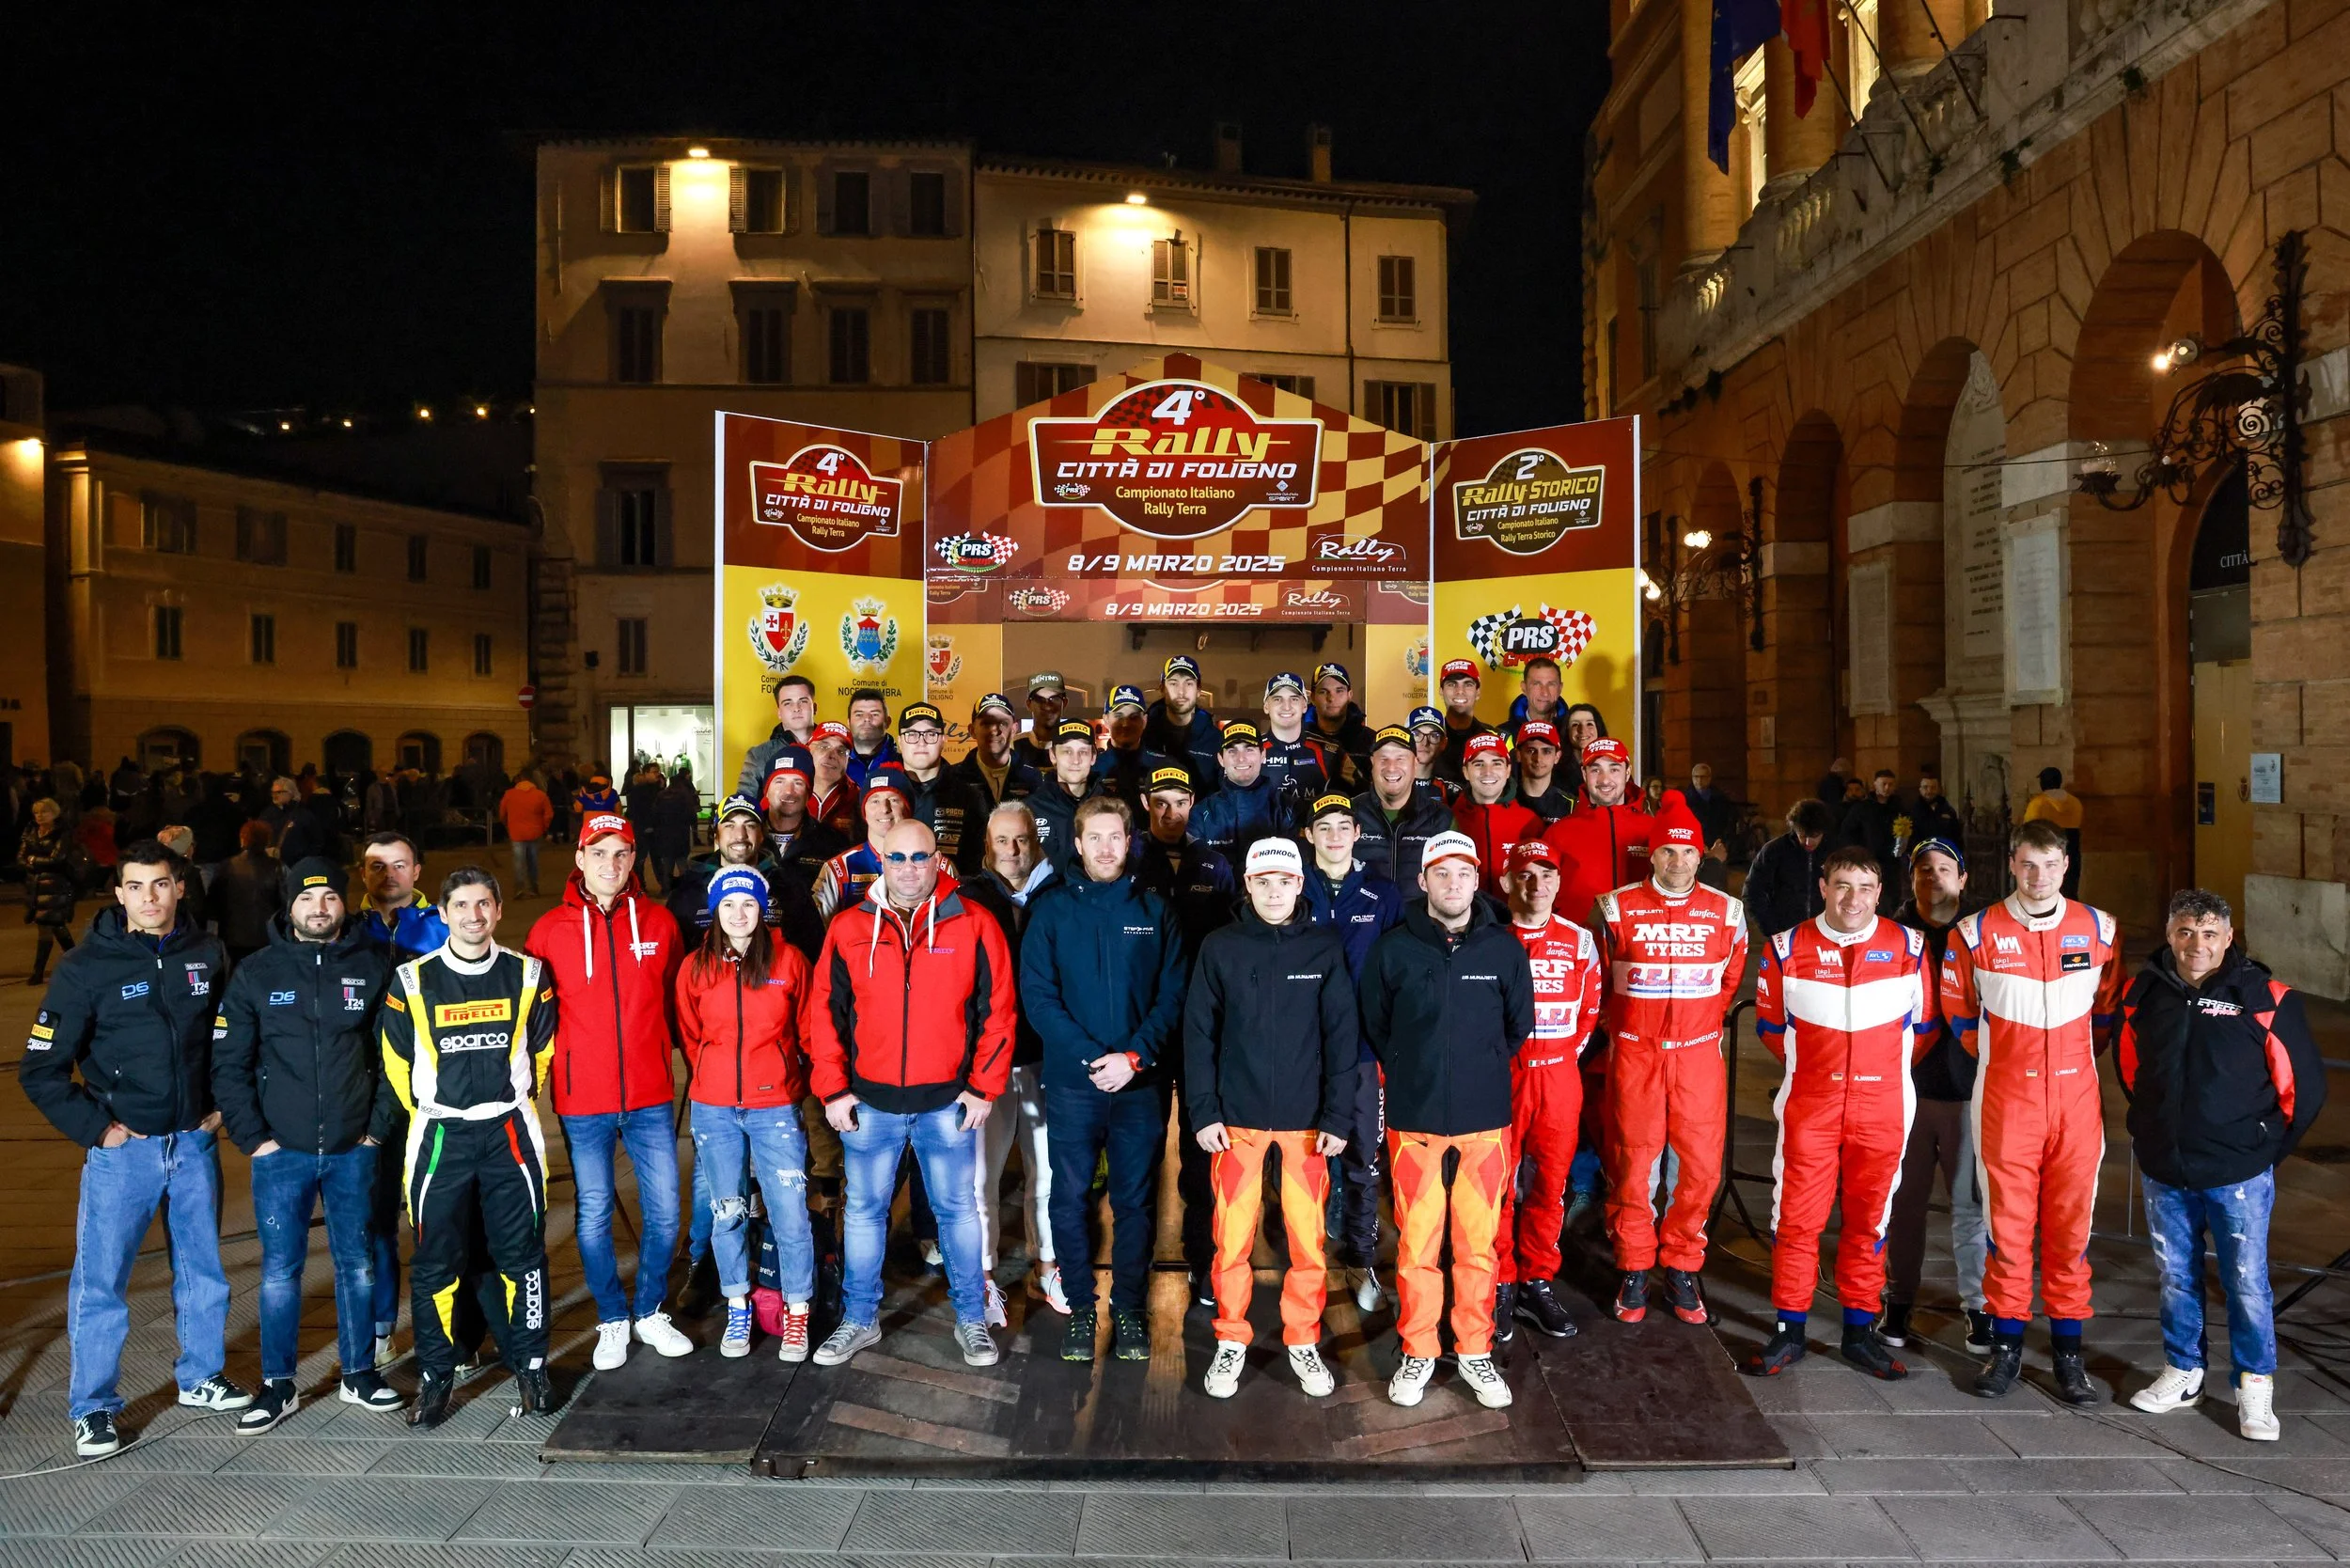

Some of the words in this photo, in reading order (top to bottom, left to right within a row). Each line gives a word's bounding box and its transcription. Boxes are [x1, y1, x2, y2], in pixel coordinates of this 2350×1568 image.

[1152, 390, 1206, 425] 4°
[1089, 427, 1291, 463] Rally
[817, 452, 845, 477] 4°
[1057, 458, 1140, 478] CITTÀ
[1146, 463, 1175, 478] DI
[1181, 463, 1297, 478] FOLIGNO
[1515, 454, 1544, 479] 2°
[784, 473, 887, 505] Rally
[1116, 486, 1188, 501] Campionato
[1190, 486, 1235, 499] Italiano
[1462, 483, 1527, 506] Rally
[1529, 476, 1598, 499] STORICO
[765, 494, 810, 509] CITTÀ
[814, 499, 828, 510] DI
[832, 501, 890, 517] FOLIGNO
[1144, 502, 1174, 517] Rally
[1176, 503, 1207, 515] Terra
[1467, 505, 1507, 522] CITTÀ
[1512, 506, 1526, 517] DI
[1529, 498, 1590, 515] FOLIGNO
[797, 513, 836, 526] Campionato
[837, 518, 860, 527] Italiano
[1497, 520, 1533, 530] Campionato
[1535, 517, 1559, 525] Italiano
[812, 526, 828, 538] Rally
[829, 527, 845, 537] Terra
[1500, 533, 1517, 543] Rally
[1534, 530, 1555, 540] Storico
[961, 543, 993, 557] PRS
[1320, 539, 1394, 562] Rally
[1068, 555, 1120, 572] 8/9
[1125, 556, 1213, 572] MARZO
[1218, 556, 1286, 572] 2025
[2220, 550, 2248, 567] CITTÀ
[1027, 595, 1051, 604] PRS
[1287, 591, 1341, 608] Rally
[1105, 604, 1144, 616] 8/9
[1147, 604, 1211, 616] MARZO
[1214, 604, 1263, 616] 2025
[1507, 625, 1554, 649] PRS
[853, 679, 879, 687] Comune
[1031, 674, 1058, 684] TRENTINO
[1525, 722, 1553, 730] MRF
[1589, 740, 1619, 750] MRF
[1155, 769, 1186, 780] PIRELLI
[1316, 797, 1349, 808] PIRELLI
[588, 815, 626, 827] MRF
[1517, 842, 1549, 853] MRF
[1359, 887, 1379, 900] sparco
[1523, 931, 1546, 939] MRF
[1632, 923, 1715, 942] MRF
[1843, 933, 1864, 942] HRX
[1581, 932, 1590, 954] sparco
[1645, 943, 1706, 957] TYRES
[1777, 934, 1785, 951] HRX
[1529, 959, 1574, 978] RF
[400, 967, 415, 989] sparco
[1533, 980, 1564, 993] RES
[270, 991, 295, 1003] D6
[444, 1004, 503, 1021] PIRELLI
[439, 1032, 509, 1052] sparco
[1619, 1031, 1638, 1042] sparco
[1684, 1031, 1718, 1047] ANDREUCCI
[421, 1105, 442, 1117] sparco
[1376, 1088, 1385, 1145] ACING
[525, 1269, 542, 1329] sparco
